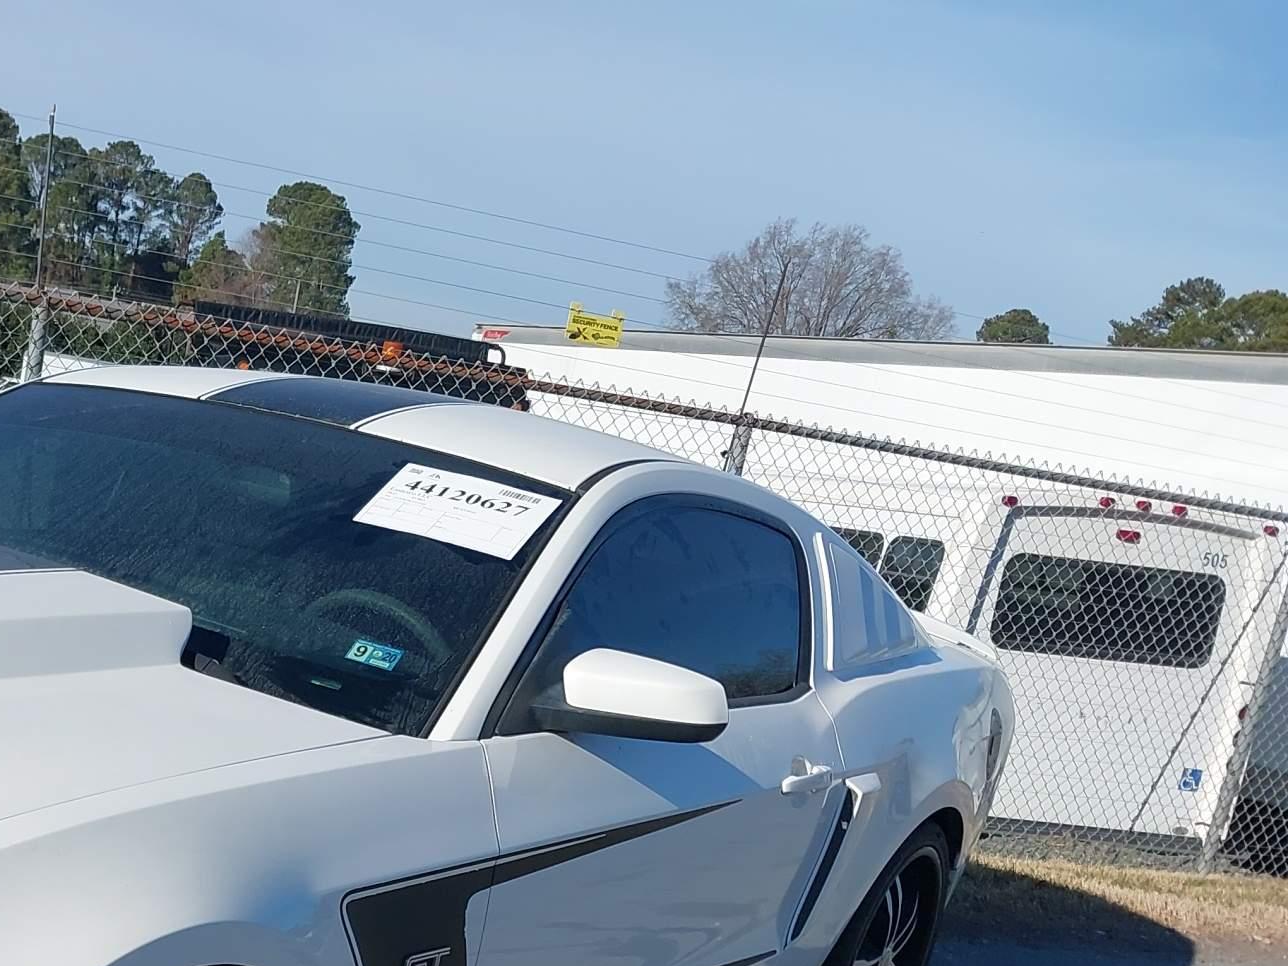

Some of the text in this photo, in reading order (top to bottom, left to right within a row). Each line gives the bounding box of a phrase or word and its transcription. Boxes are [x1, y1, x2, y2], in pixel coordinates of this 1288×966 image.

[572, 317, 600, 329] SECURITY
[600, 323, 619, 332] FENCE
[404, 479, 531, 517] 44120627
[1203, 552, 1229, 569] 505
[353, 645, 368, 657] 9
